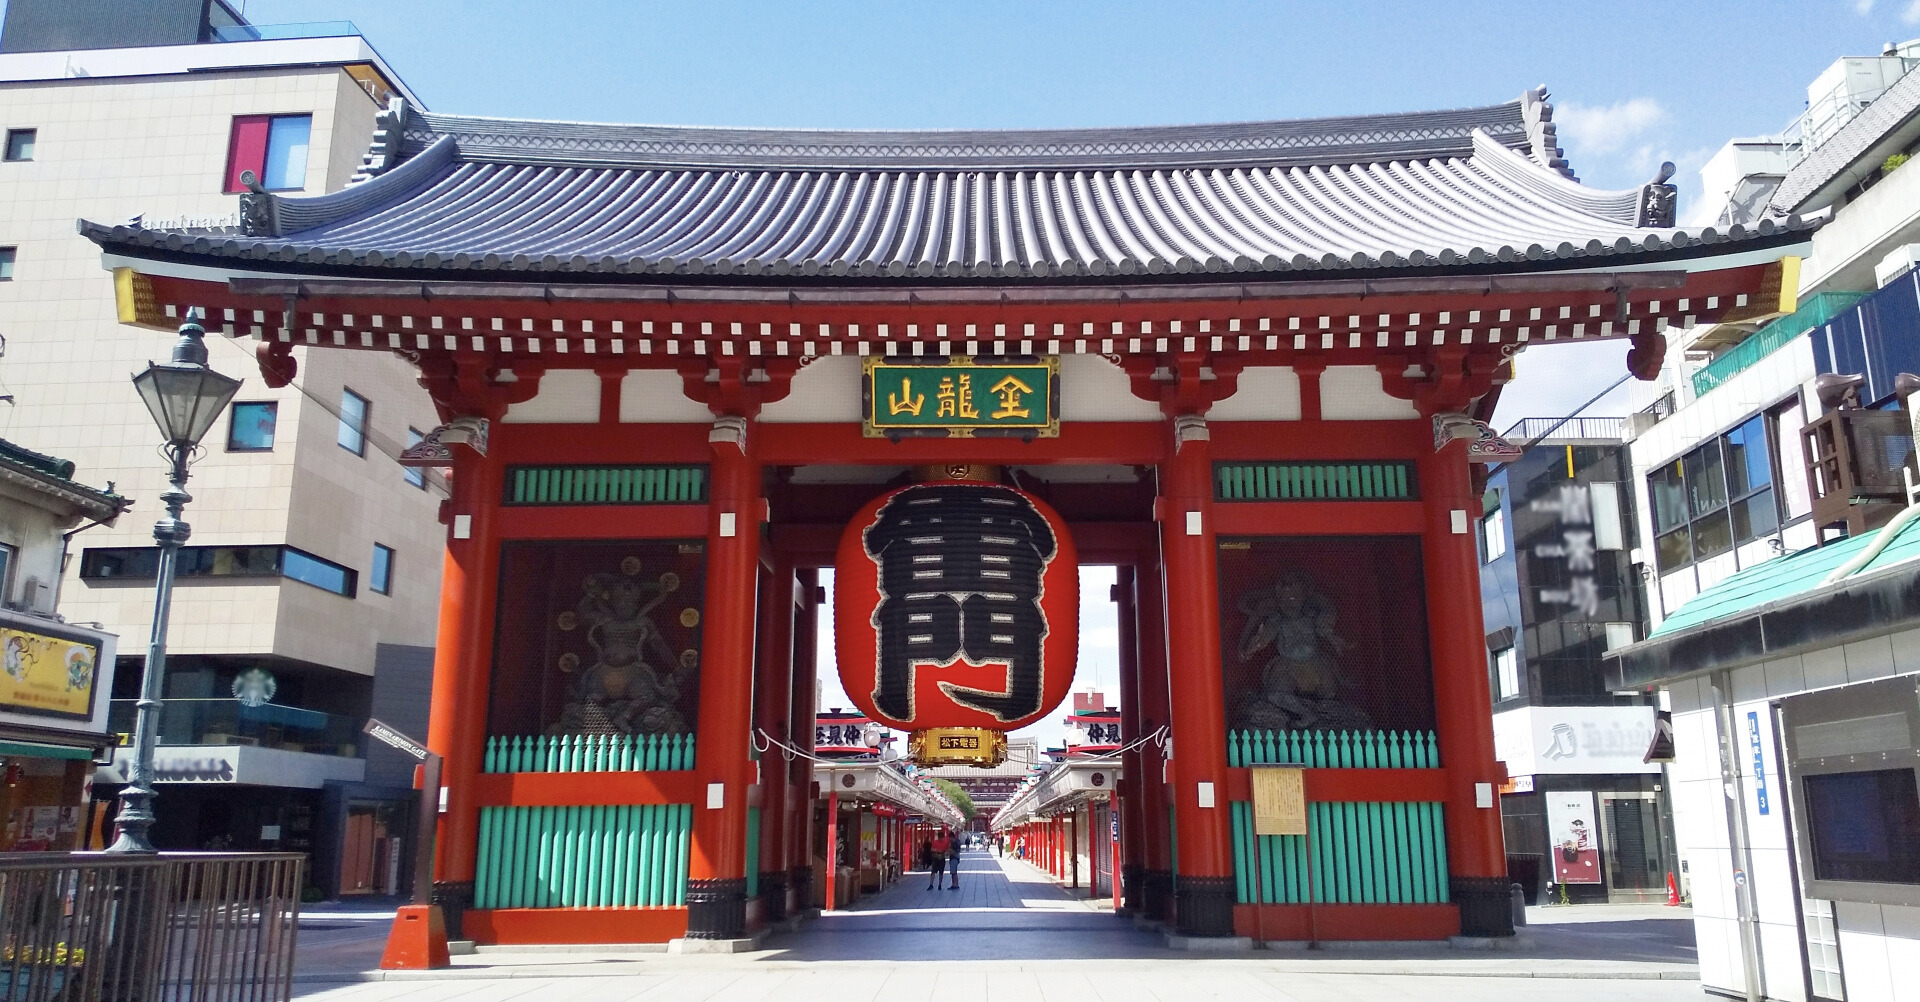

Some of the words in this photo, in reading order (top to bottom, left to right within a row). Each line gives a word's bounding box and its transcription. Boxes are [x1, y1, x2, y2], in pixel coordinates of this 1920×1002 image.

[862, 484, 1058, 722] 雷門
[374, 725, 412, 749] KAMINARIMON
[411, 746, 427, 757] GATE
[941, 738, 978, 748] 松下電器
[1087, 723, 1121, 743] 仲見
[1760, 797, 1766, 808] 3
